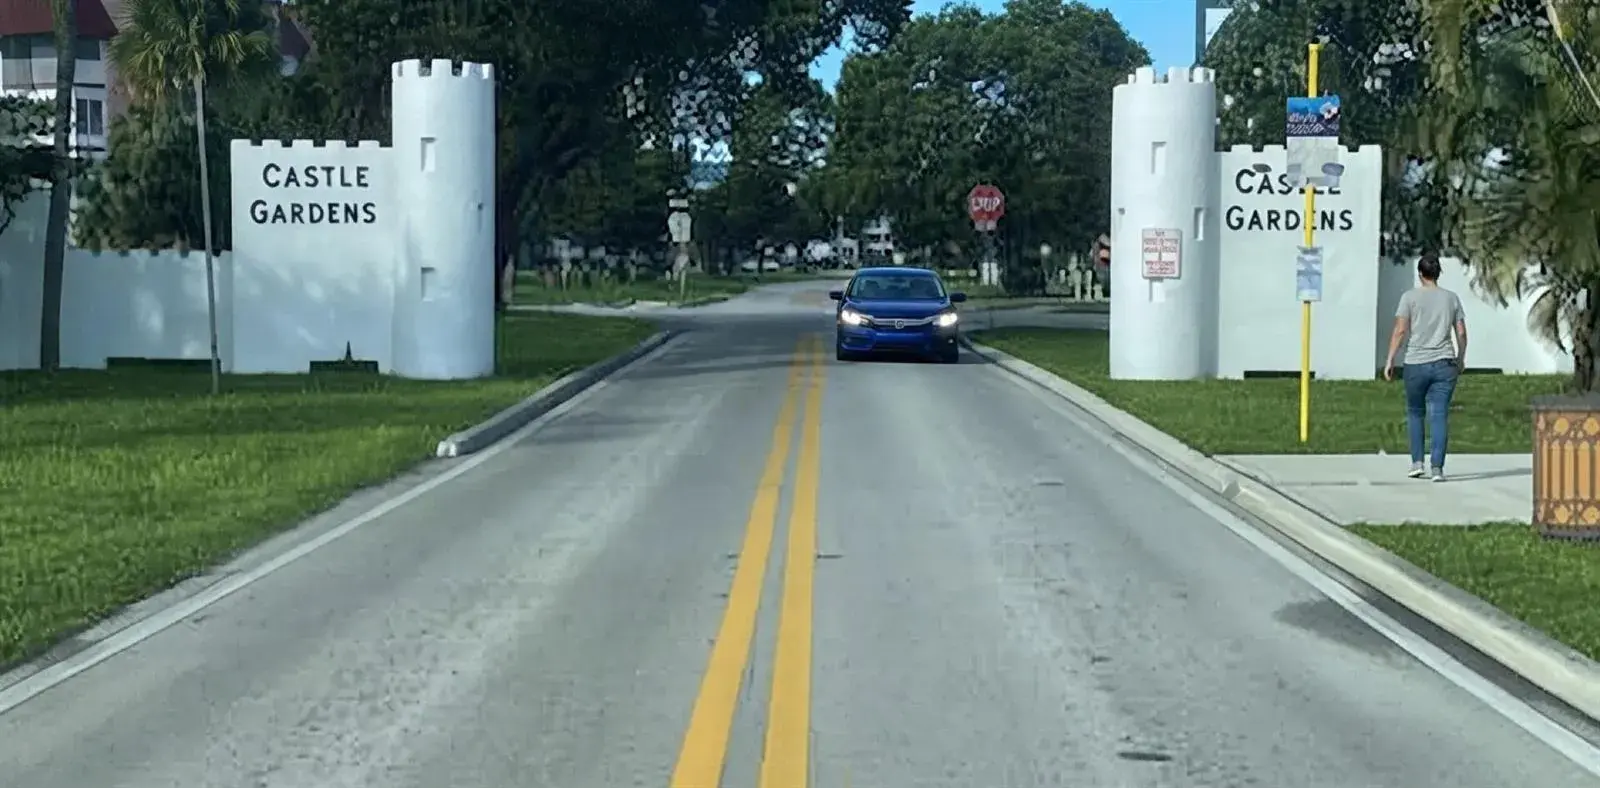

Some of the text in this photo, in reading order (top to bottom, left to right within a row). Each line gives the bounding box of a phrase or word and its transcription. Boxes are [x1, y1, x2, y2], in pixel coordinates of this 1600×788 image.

[262, 163, 369, 188] CASTLE
[1235, 169, 1341, 195] CAS
[250, 199, 377, 224] GARDENS
[1226, 205, 1353, 231] GARDNS
